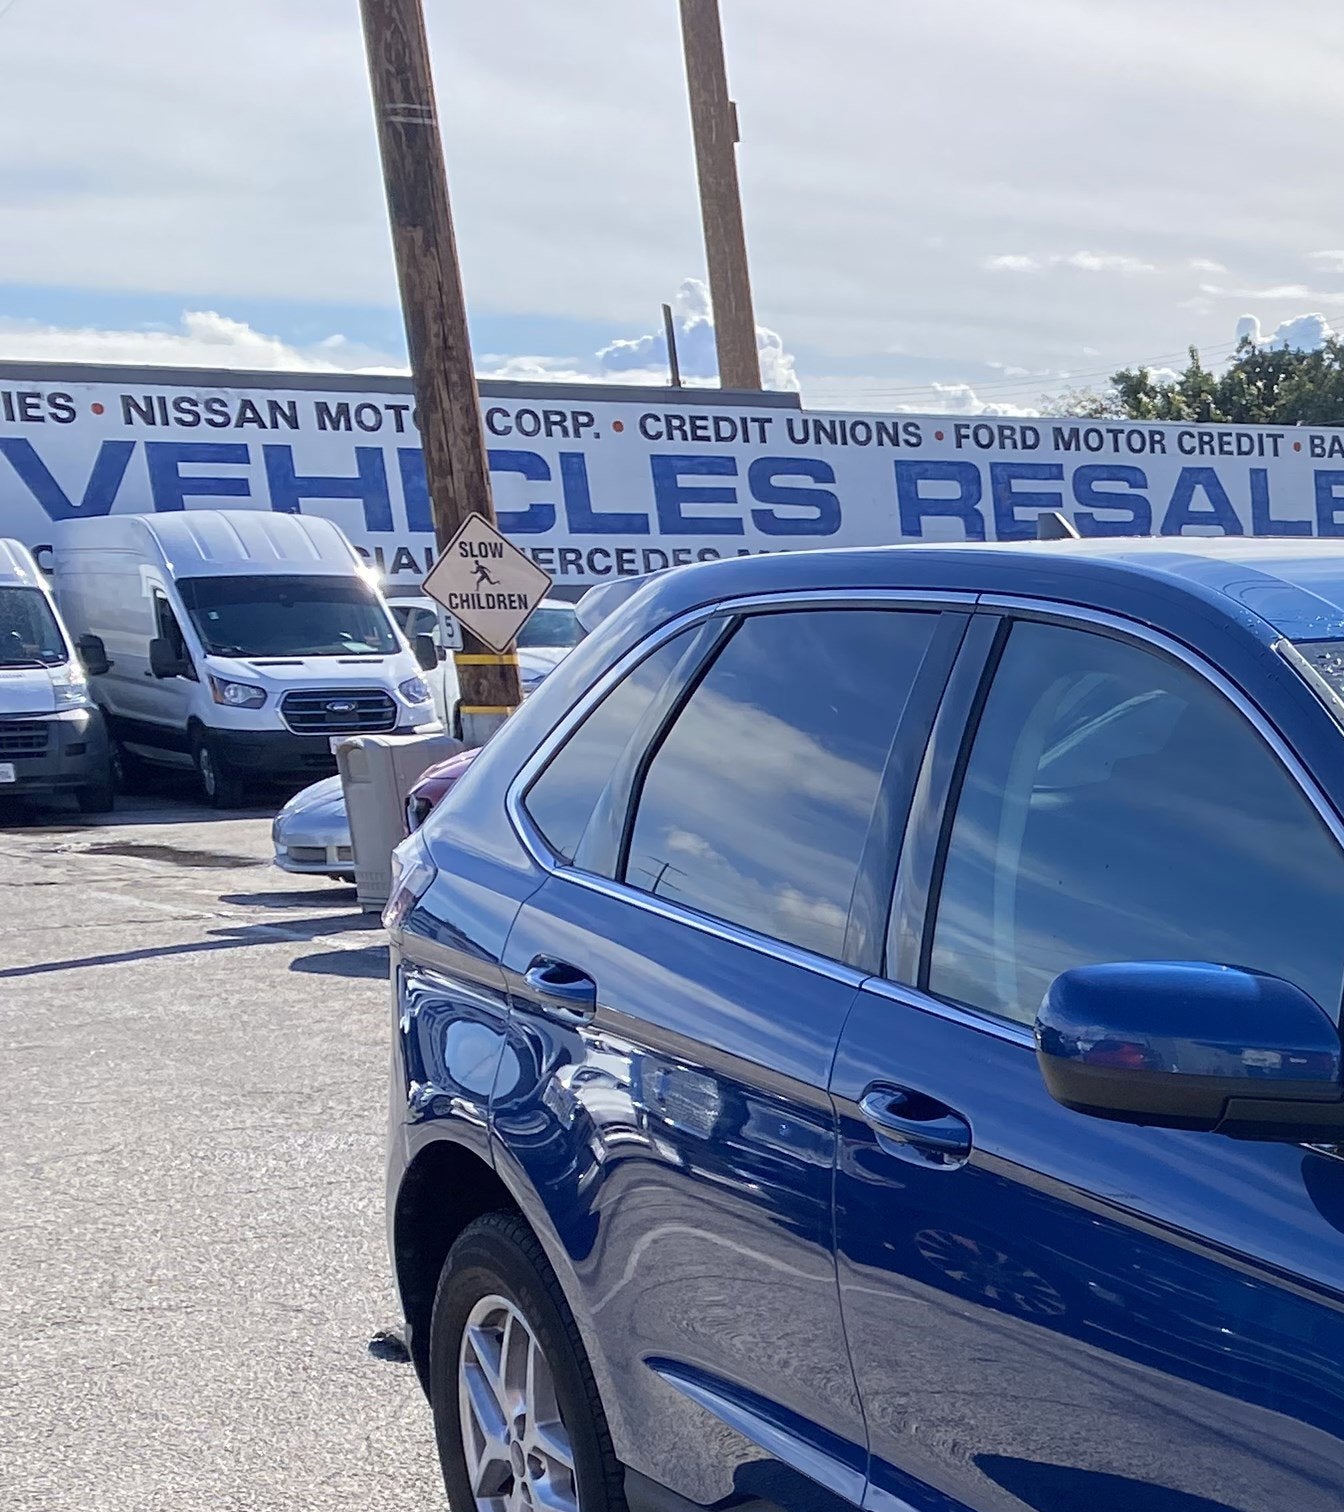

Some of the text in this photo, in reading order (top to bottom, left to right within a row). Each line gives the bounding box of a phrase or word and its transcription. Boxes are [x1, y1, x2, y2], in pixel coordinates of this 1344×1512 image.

[120, 394, 301, 430] NISSAN
[314, 401, 423, 433] MOT
[485, 407, 600, 439] CORP.
[638, 412, 773, 444] CREDIT
[786, 418, 923, 448] UNIONS
[953, 422, 1041, 451] FORD
[1052, 425, 1167, 455] MOTOR
[1176, 429, 1285, 458] CREDIT
[0, 437, 842, 536] VEHICLES
[459, 541, 504, 558] SLOW
[448, 592, 529, 610] CHILDREN
[444, 615, 455, 638] 5
